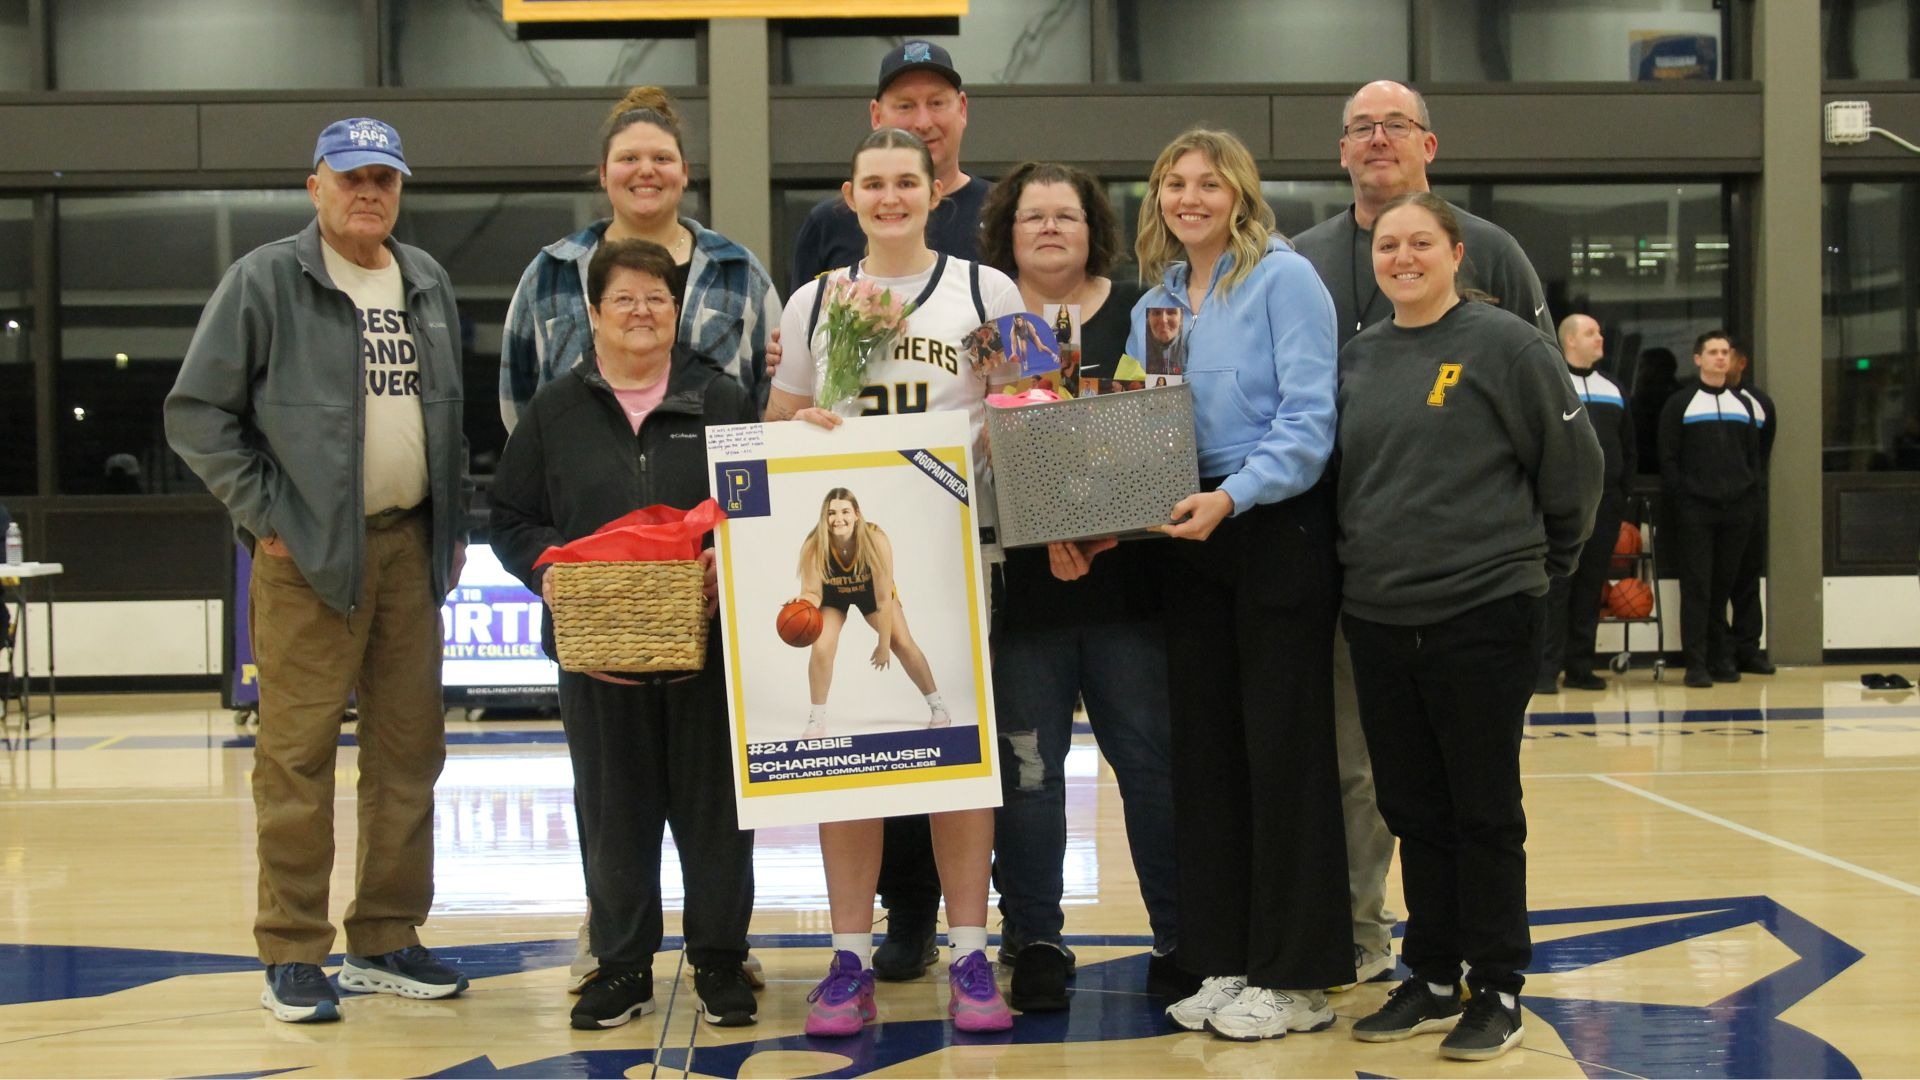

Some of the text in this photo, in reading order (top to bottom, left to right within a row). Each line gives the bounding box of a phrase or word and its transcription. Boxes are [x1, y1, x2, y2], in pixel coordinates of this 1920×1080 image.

[350, 129, 389, 145] PAPA
[355, 308, 411, 334] BEST
[880, 337, 958, 375] HERS
[1427, 363, 1463, 406] P
[913, 450, 968, 498] #GOPANTHERS
[461, 588, 482, 602] TO
[478, 644, 538, 657] COLLEGE
[748, 737, 853, 756] #24 ABBIE
[749, 747, 941, 774] SCHARRINGHAUSEN
[768, 760, 936, 781] PORTLAND COMMUNITY COLLEGE
